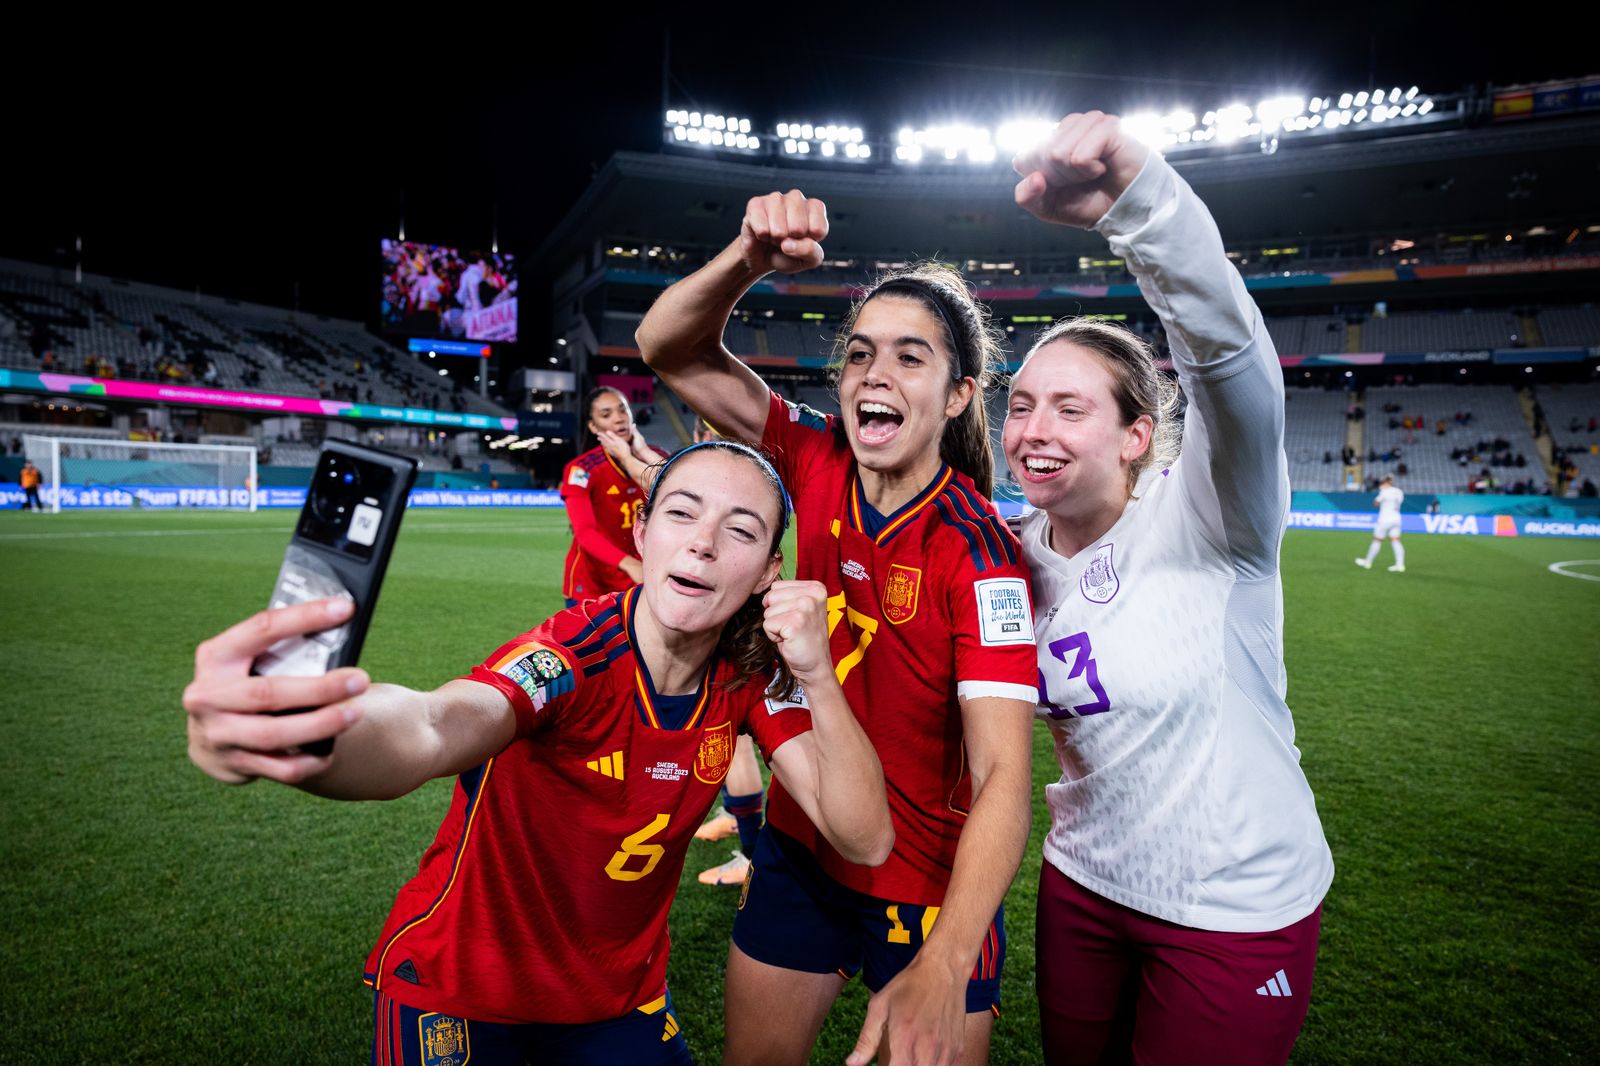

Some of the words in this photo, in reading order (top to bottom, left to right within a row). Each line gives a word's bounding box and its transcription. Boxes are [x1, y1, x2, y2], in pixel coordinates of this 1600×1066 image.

[179, 489, 218, 505] FIFA
[219, 489, 268, 505] STOE
[1420, 514, 1478, 535] VISA
[1525, 522, 1600, 537] AUCKLAN
[990, 589, 1020, 598] FOOTBALL
[991, 598, 1023, 610] UNITES
[1005, 610, 1026, 622] World
[652, 773, 680, 781] AUCKLAND
[604, 814, 671, 881] 6
